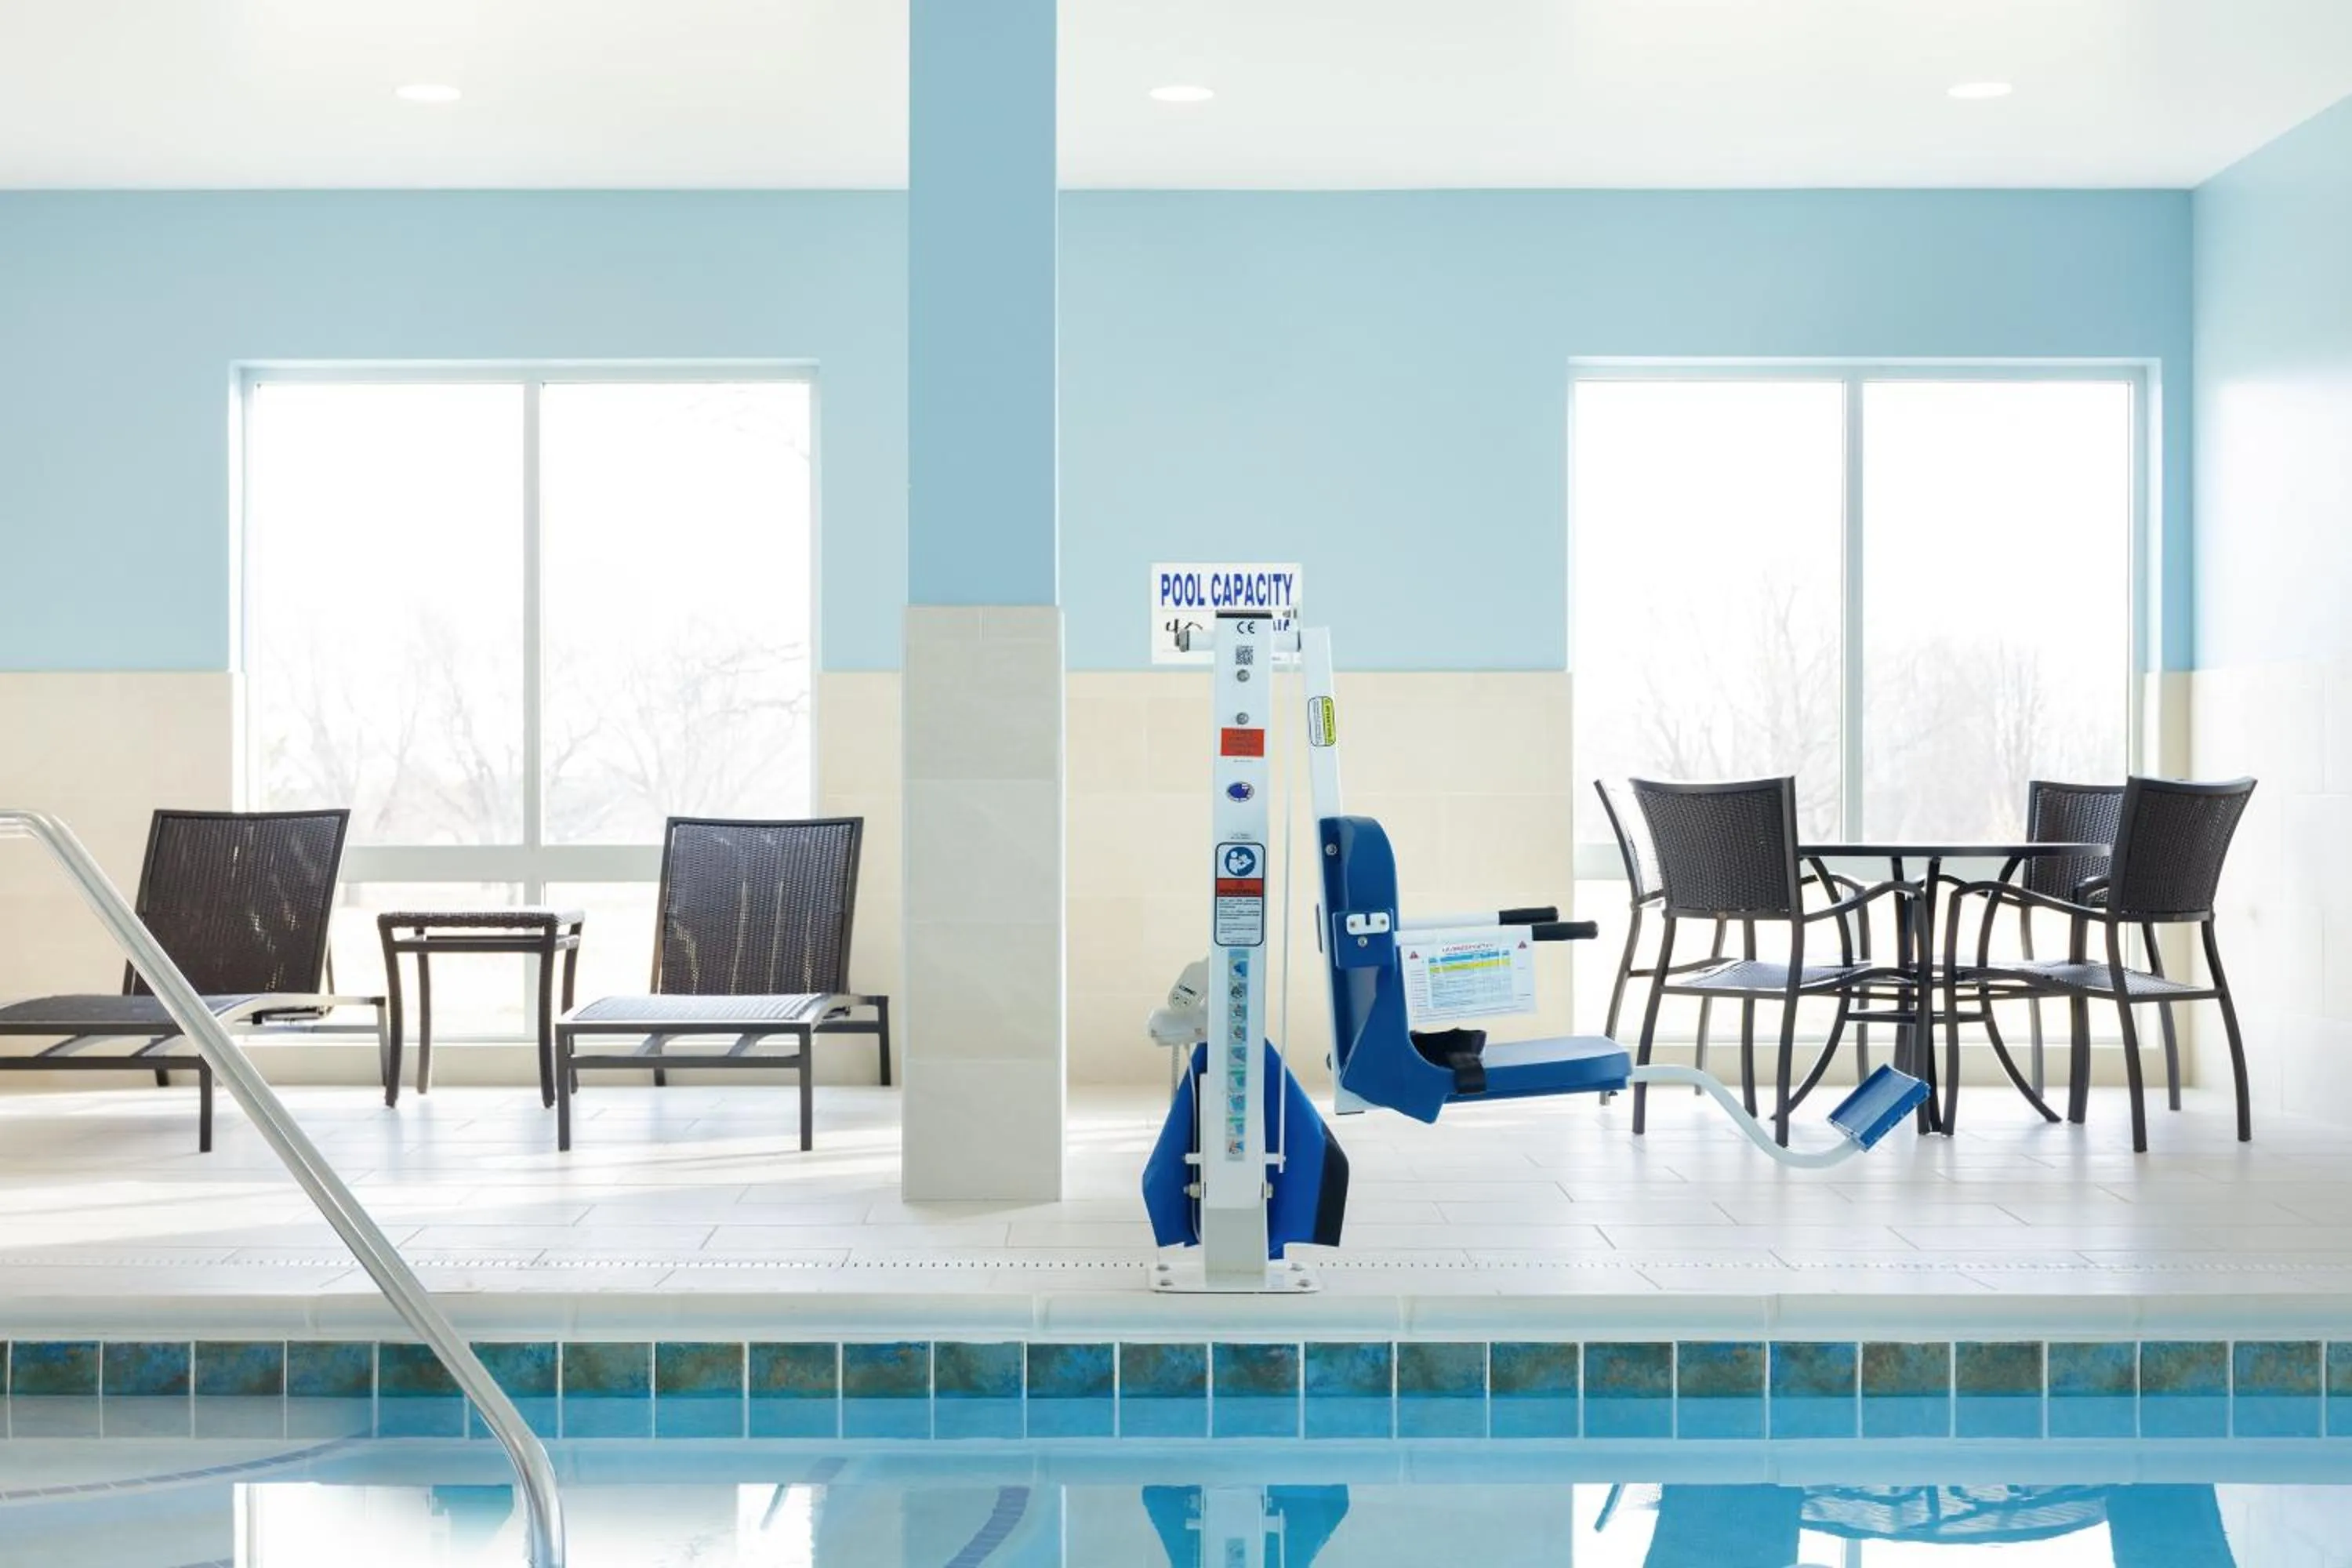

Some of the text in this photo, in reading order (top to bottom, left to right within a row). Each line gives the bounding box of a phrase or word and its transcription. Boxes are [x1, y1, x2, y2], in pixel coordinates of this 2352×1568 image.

[1161, 573, 1293, 606] POOL CAPACITY
[1236, 620, 1255, 634] CE
